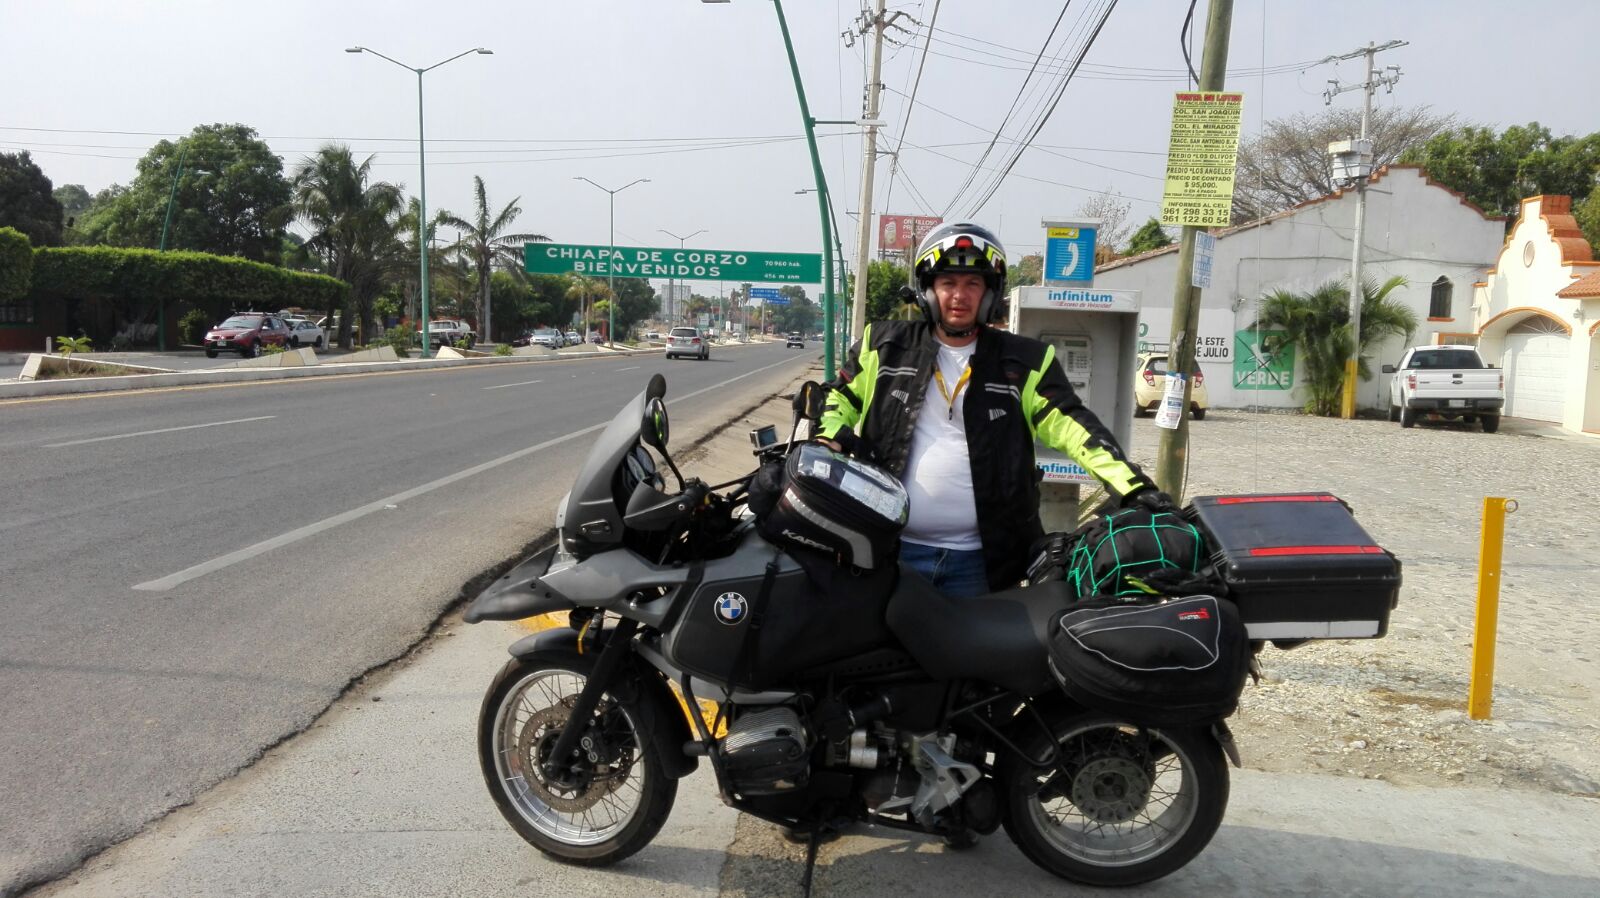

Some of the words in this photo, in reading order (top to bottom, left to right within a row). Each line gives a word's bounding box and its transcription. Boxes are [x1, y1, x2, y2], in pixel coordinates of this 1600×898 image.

[546, 247, 625, 260] CHIAPA
[637, 251, 662, 262] DE
[674, 252, 747, 265] CORZO
[574, 262, 720, 277] BIENVENIDOS
[1048, 289, 1113, 302] infinitum
[1205, 337, 1225, 346] ESTE
[1204, 347, 1229, 358] JULIO
[1236, 371, 1290, 385] VERDE
